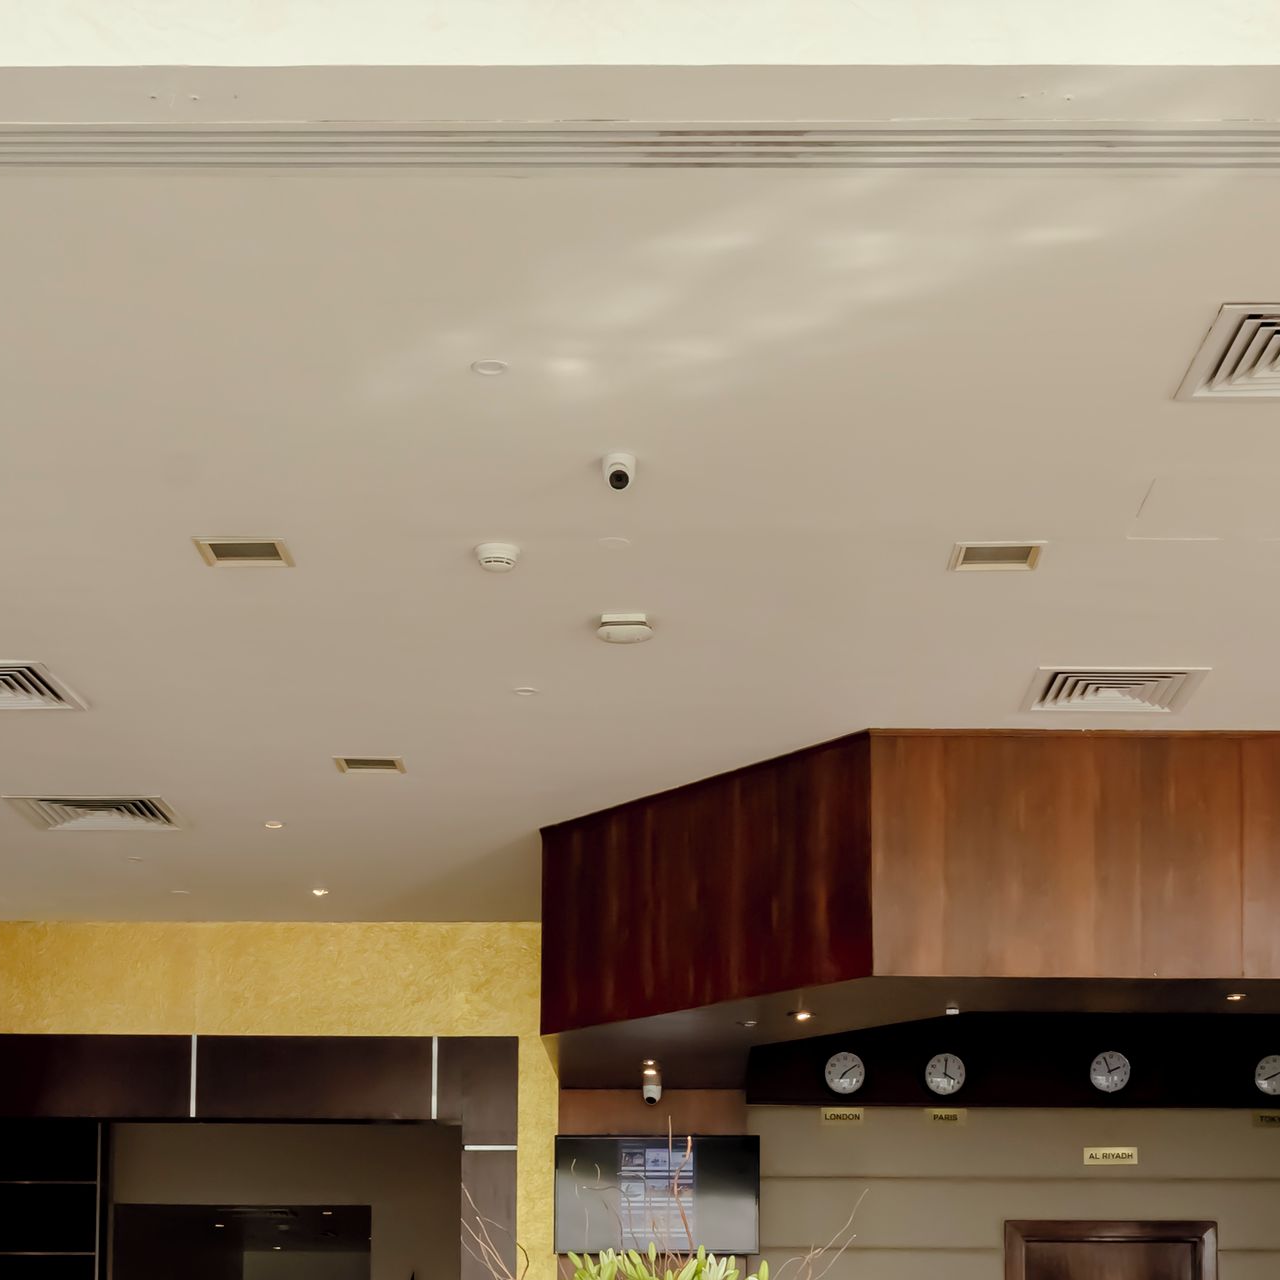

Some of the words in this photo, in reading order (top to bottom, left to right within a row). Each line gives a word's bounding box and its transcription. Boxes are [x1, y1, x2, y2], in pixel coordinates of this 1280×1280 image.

[824, 1113, 860, 1121] LONDON
[933, 1113, 958, 1121] PARIS
[1088, 1152, 1100, 1160] AL
[1102, 1152, 1133, 1160] RIYADH
